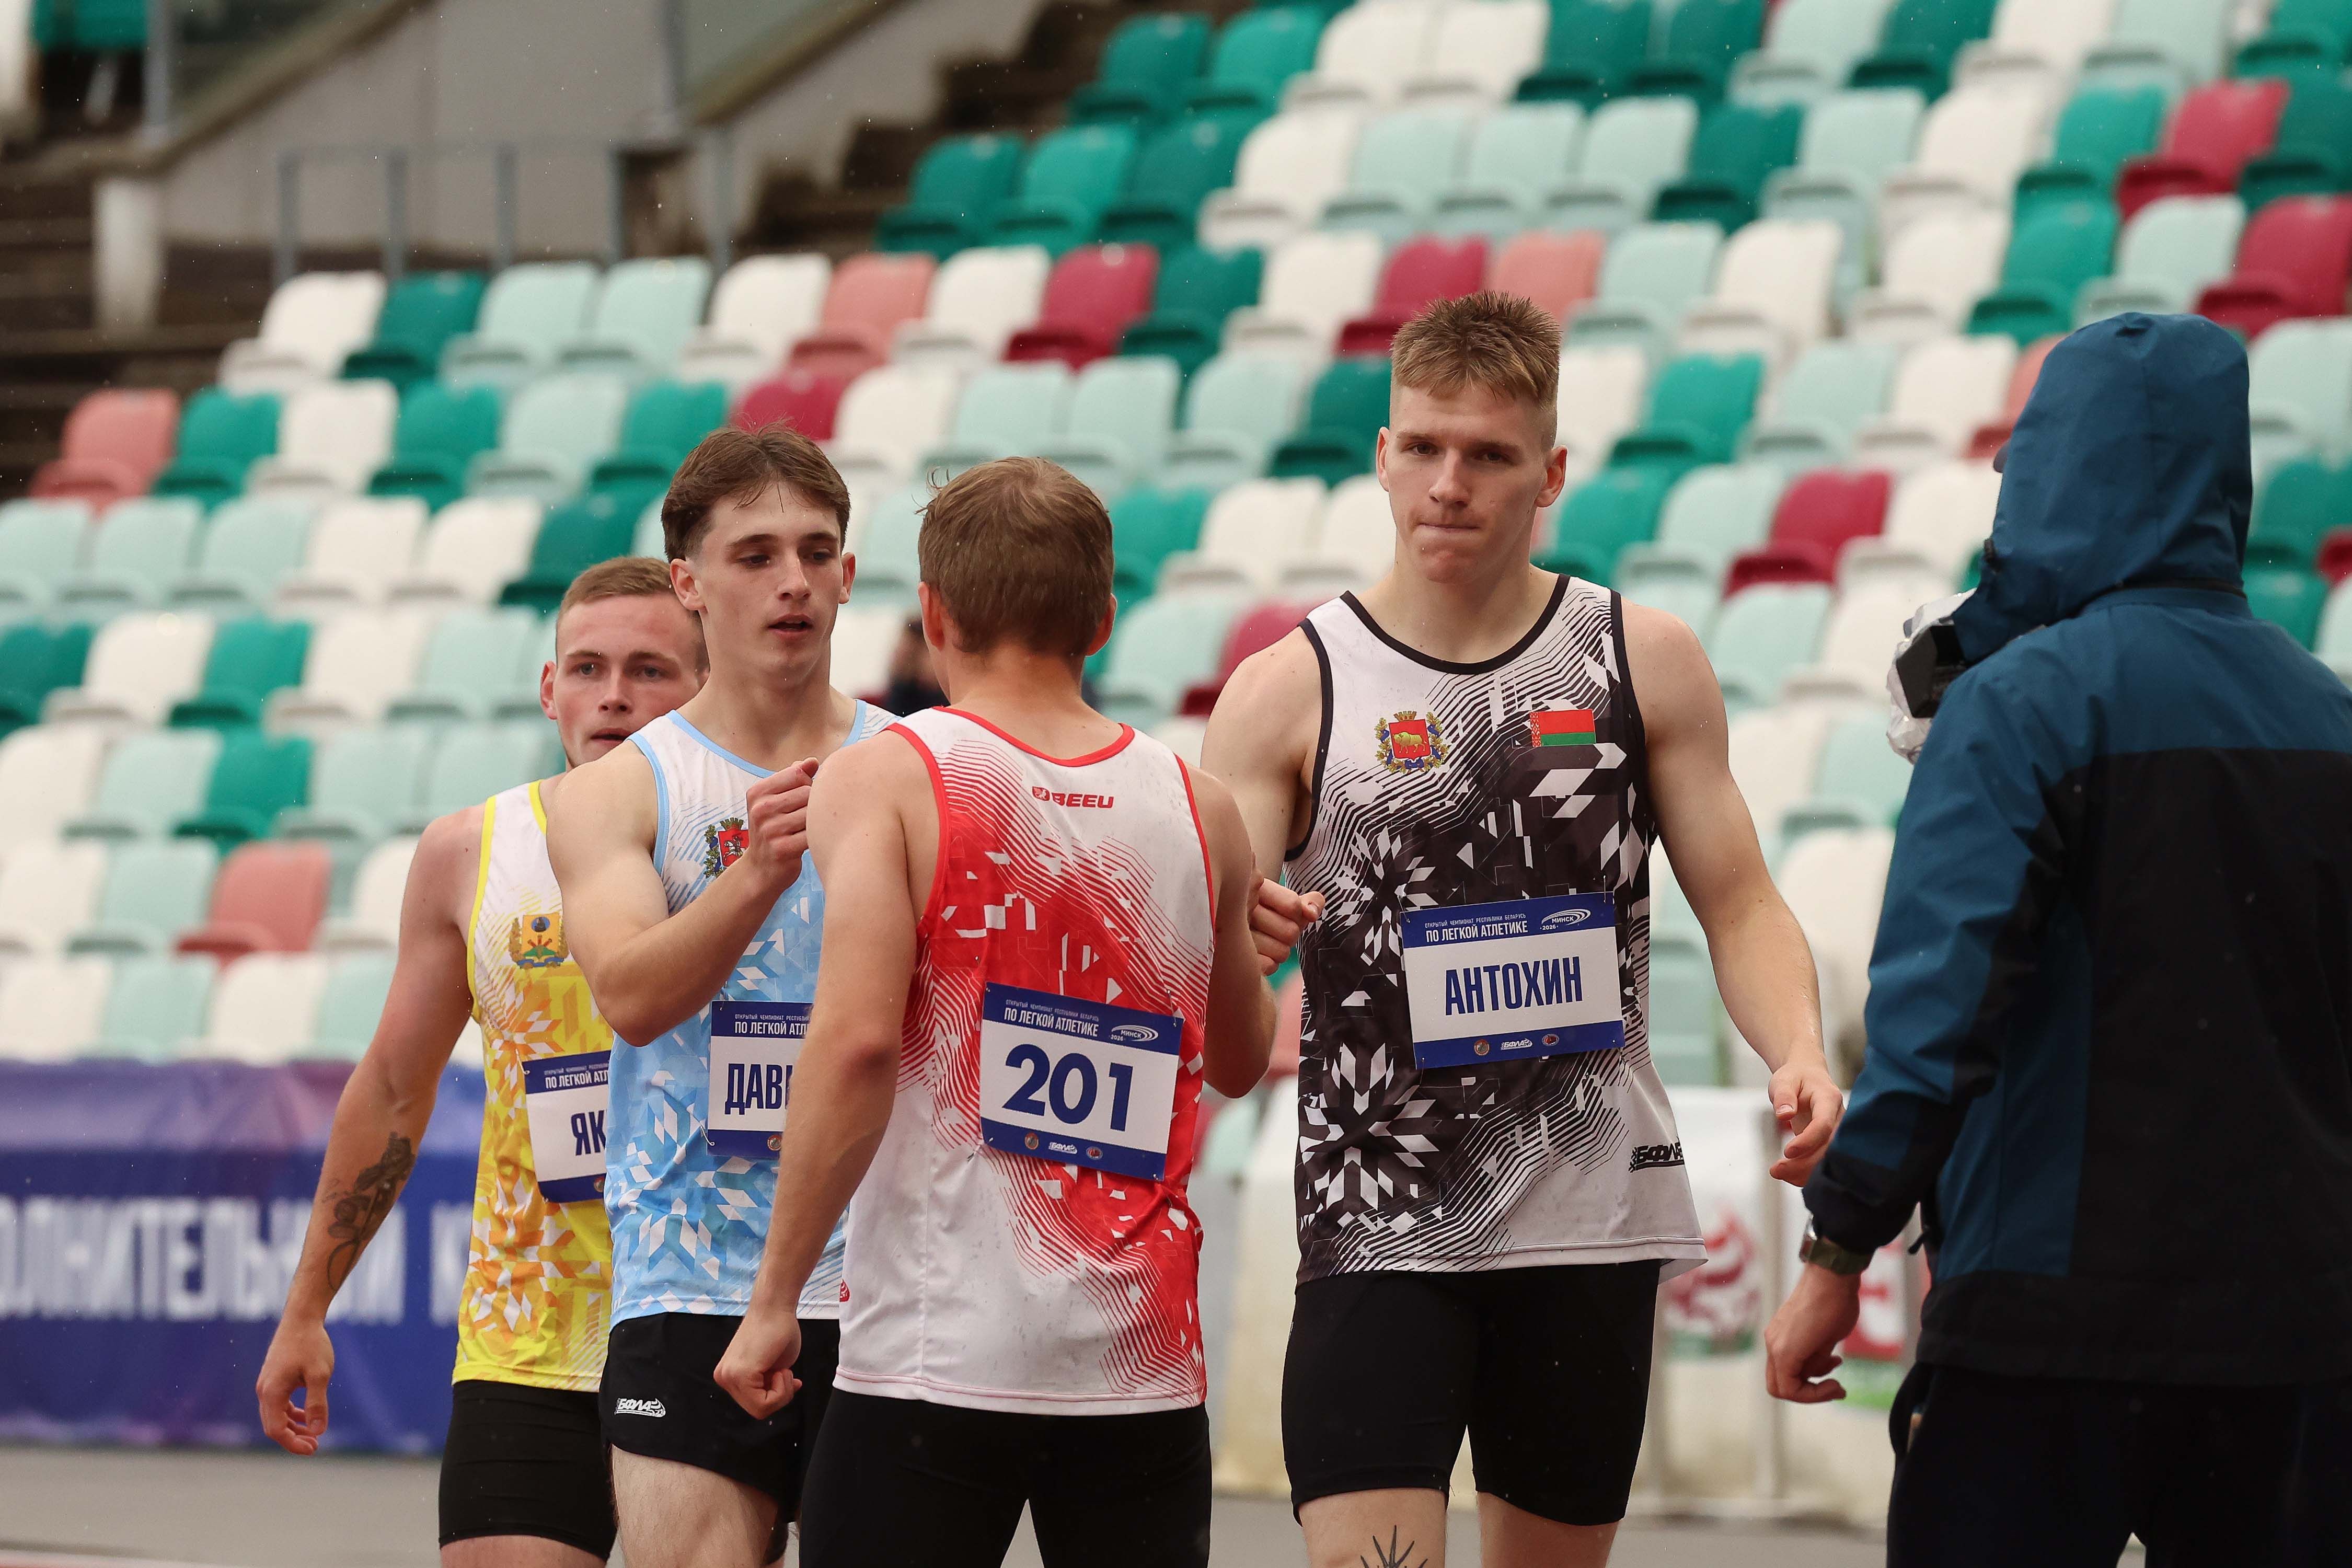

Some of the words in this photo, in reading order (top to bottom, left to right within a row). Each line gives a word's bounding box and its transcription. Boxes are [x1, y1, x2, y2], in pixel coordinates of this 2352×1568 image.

[1425, 920, 1448, 928] ОТКРЫТЫЙ
[1426, 930, 1438, 942] ПО
[1442, 924, 1479, 941] ЛЕГКОЙ
[1481, 920, 1528, 937] АТЛЕТИКЕ
[1445, 956, 1583, 1016] АНТОХИН
[735, 1022, 747, 1033] ПО
[750, 1021, 787, 1034] ЛЕГКОЙ
[789, 1023, 809, 1035] АТЛ
[1004, 1007, 1017, 1021] ПО
[1019, 1010, 1054, 1029] ЛЕГКОЙ
[1055, 1017, 1099, 1036] АТЛЕТИКЕ
[1121, 1030, 1142, 1038] МИНСК
[545, 1076, 557, 1089] ПО
[559, 1070, 592, 1087] ЛЕГКОЙ
[1002, 1044, 1133, 1132] 201
